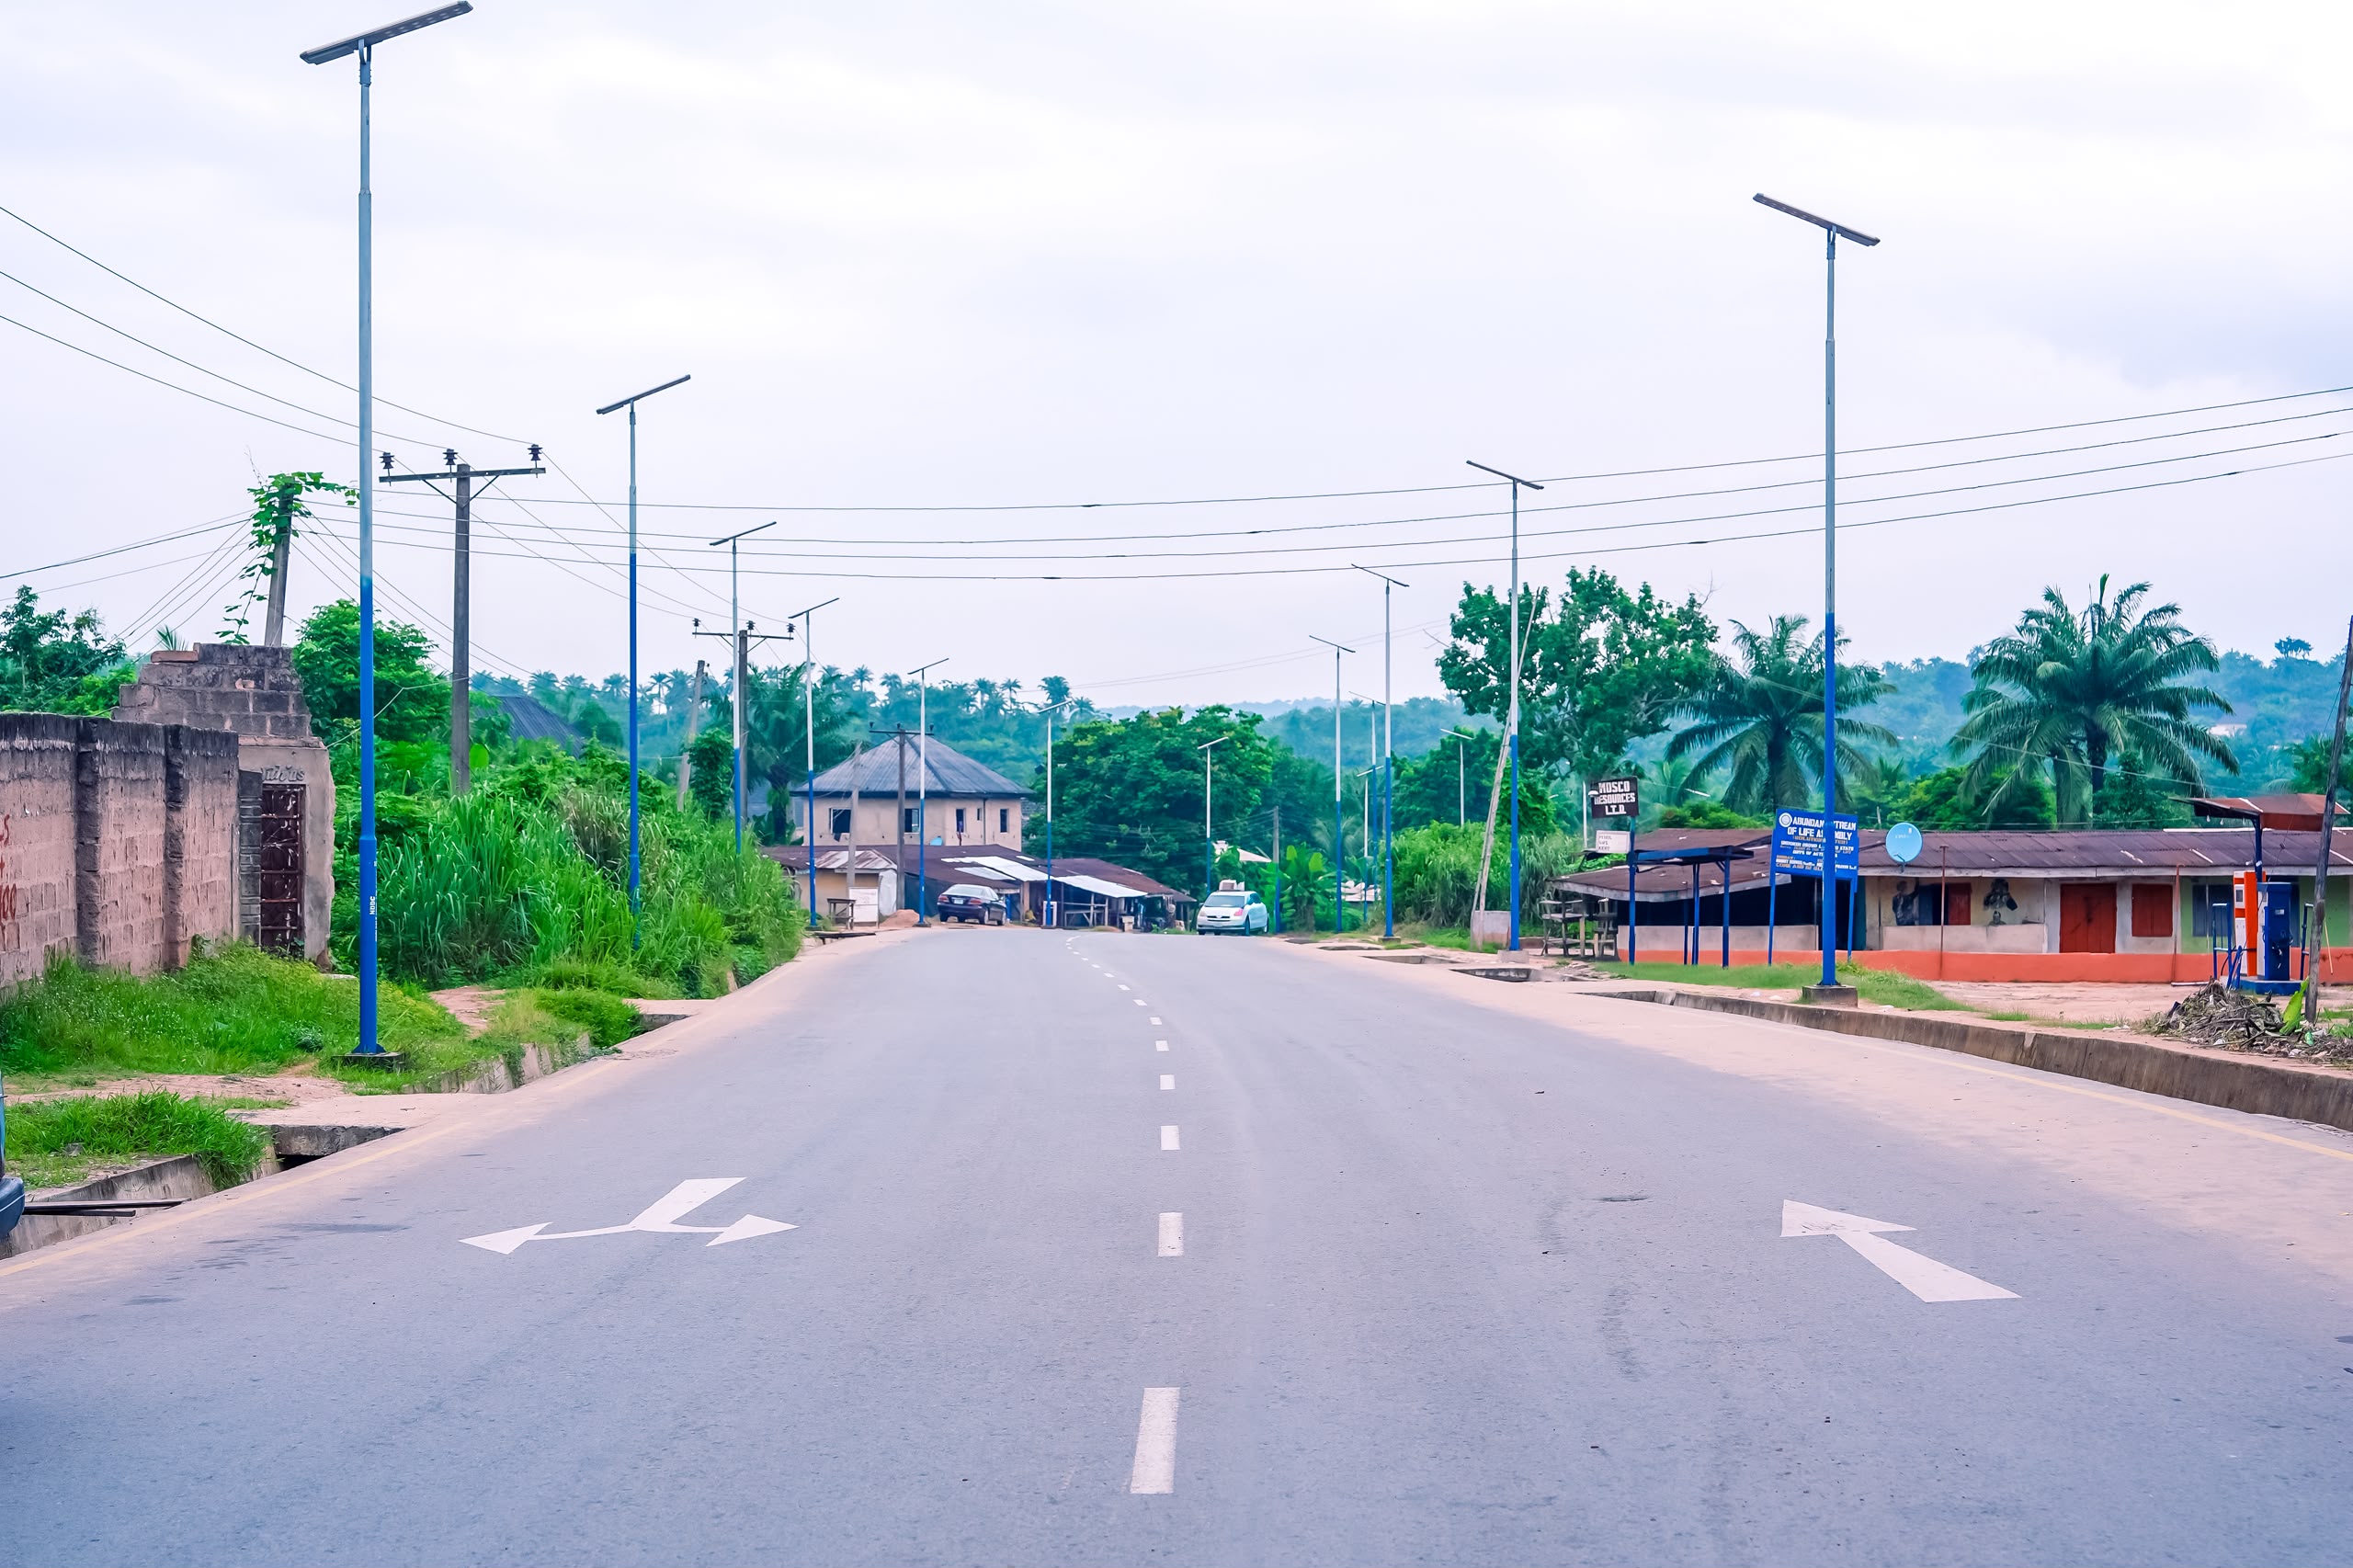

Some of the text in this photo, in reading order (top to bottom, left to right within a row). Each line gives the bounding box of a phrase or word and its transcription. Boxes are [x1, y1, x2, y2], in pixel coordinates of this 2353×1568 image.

[1598, 780, 1631, 793] MOSCO
[1594, 792, 1635, 804] RESOURCES
[1792, 816, 1856, 831] ABUNDAN TREAM
[1799, 827, 1814, 837] LIFE
